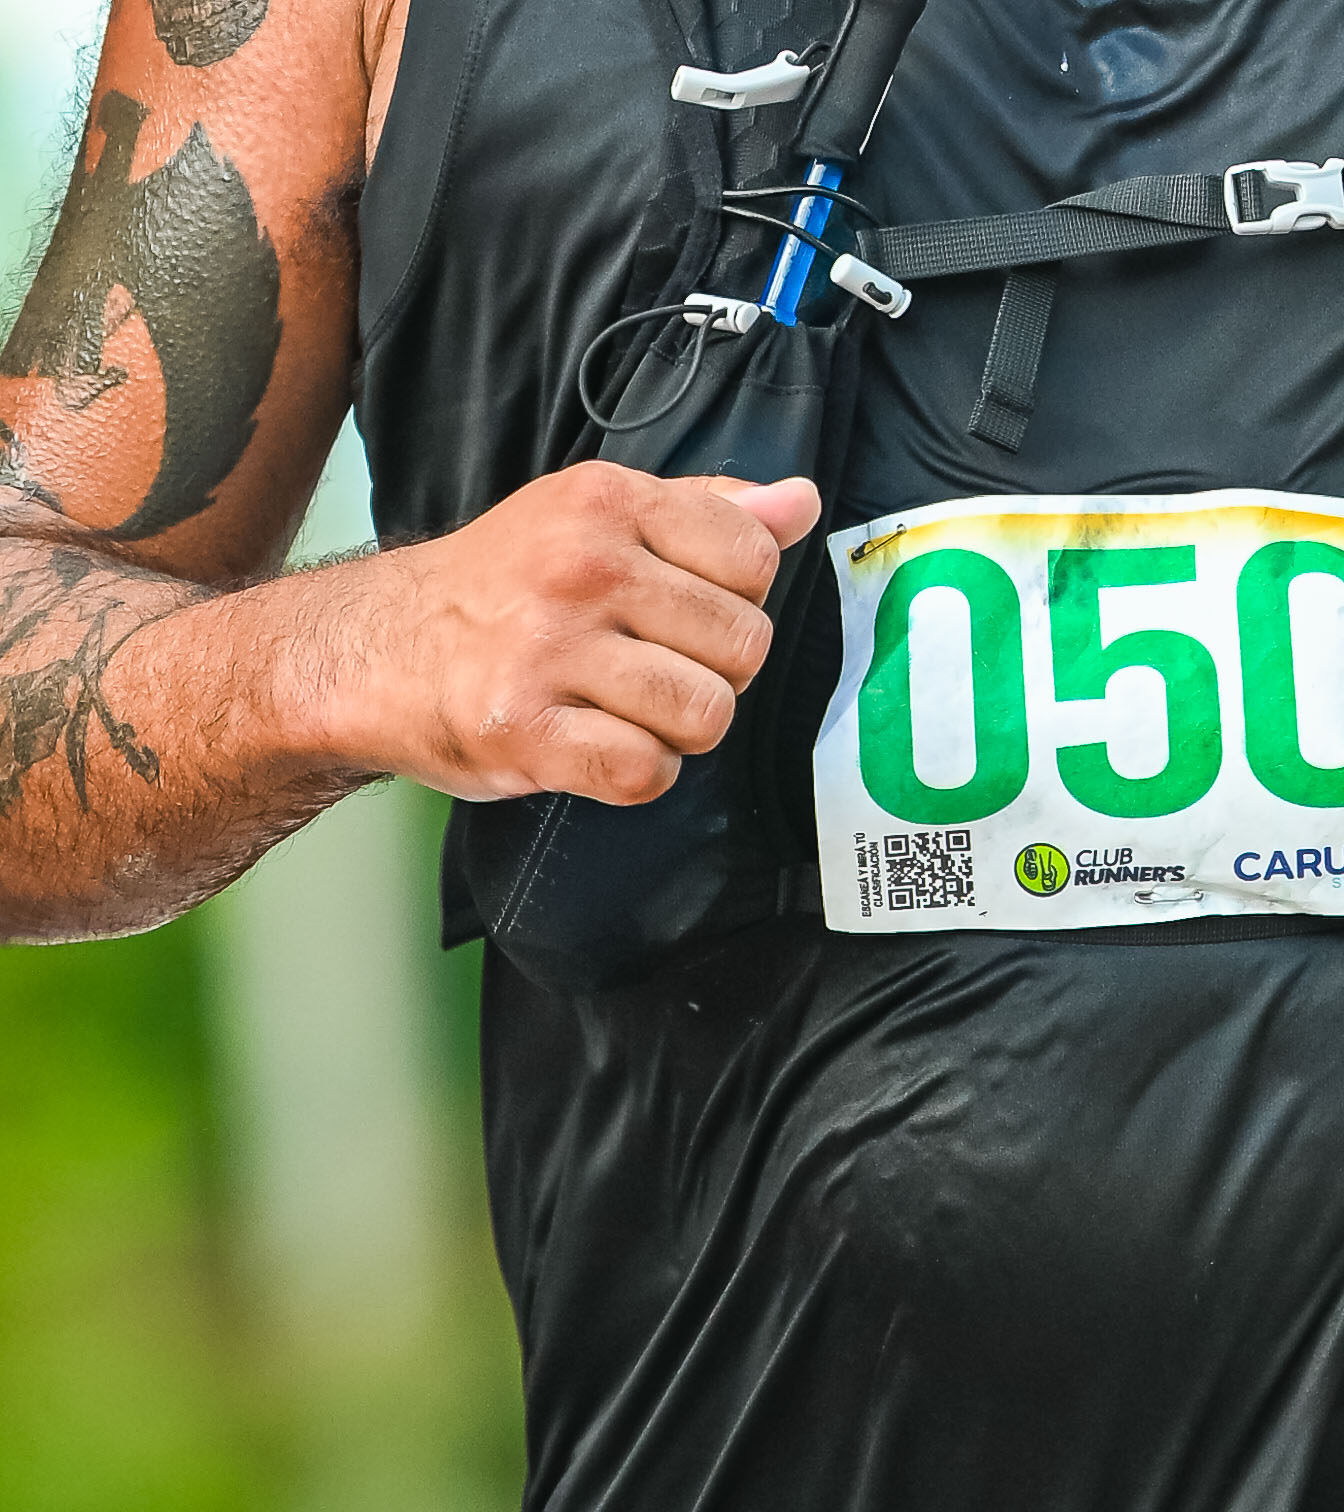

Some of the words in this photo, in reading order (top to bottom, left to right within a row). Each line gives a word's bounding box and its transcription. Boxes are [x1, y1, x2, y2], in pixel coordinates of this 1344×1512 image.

[853, 832, 866, 844] TÚ
[1075, 847, 1133, 868] CLUB
[867, 842, 883, 907] CLASIFICACIÓN
[1073, 865, 1185, 886] RUNNER'S
